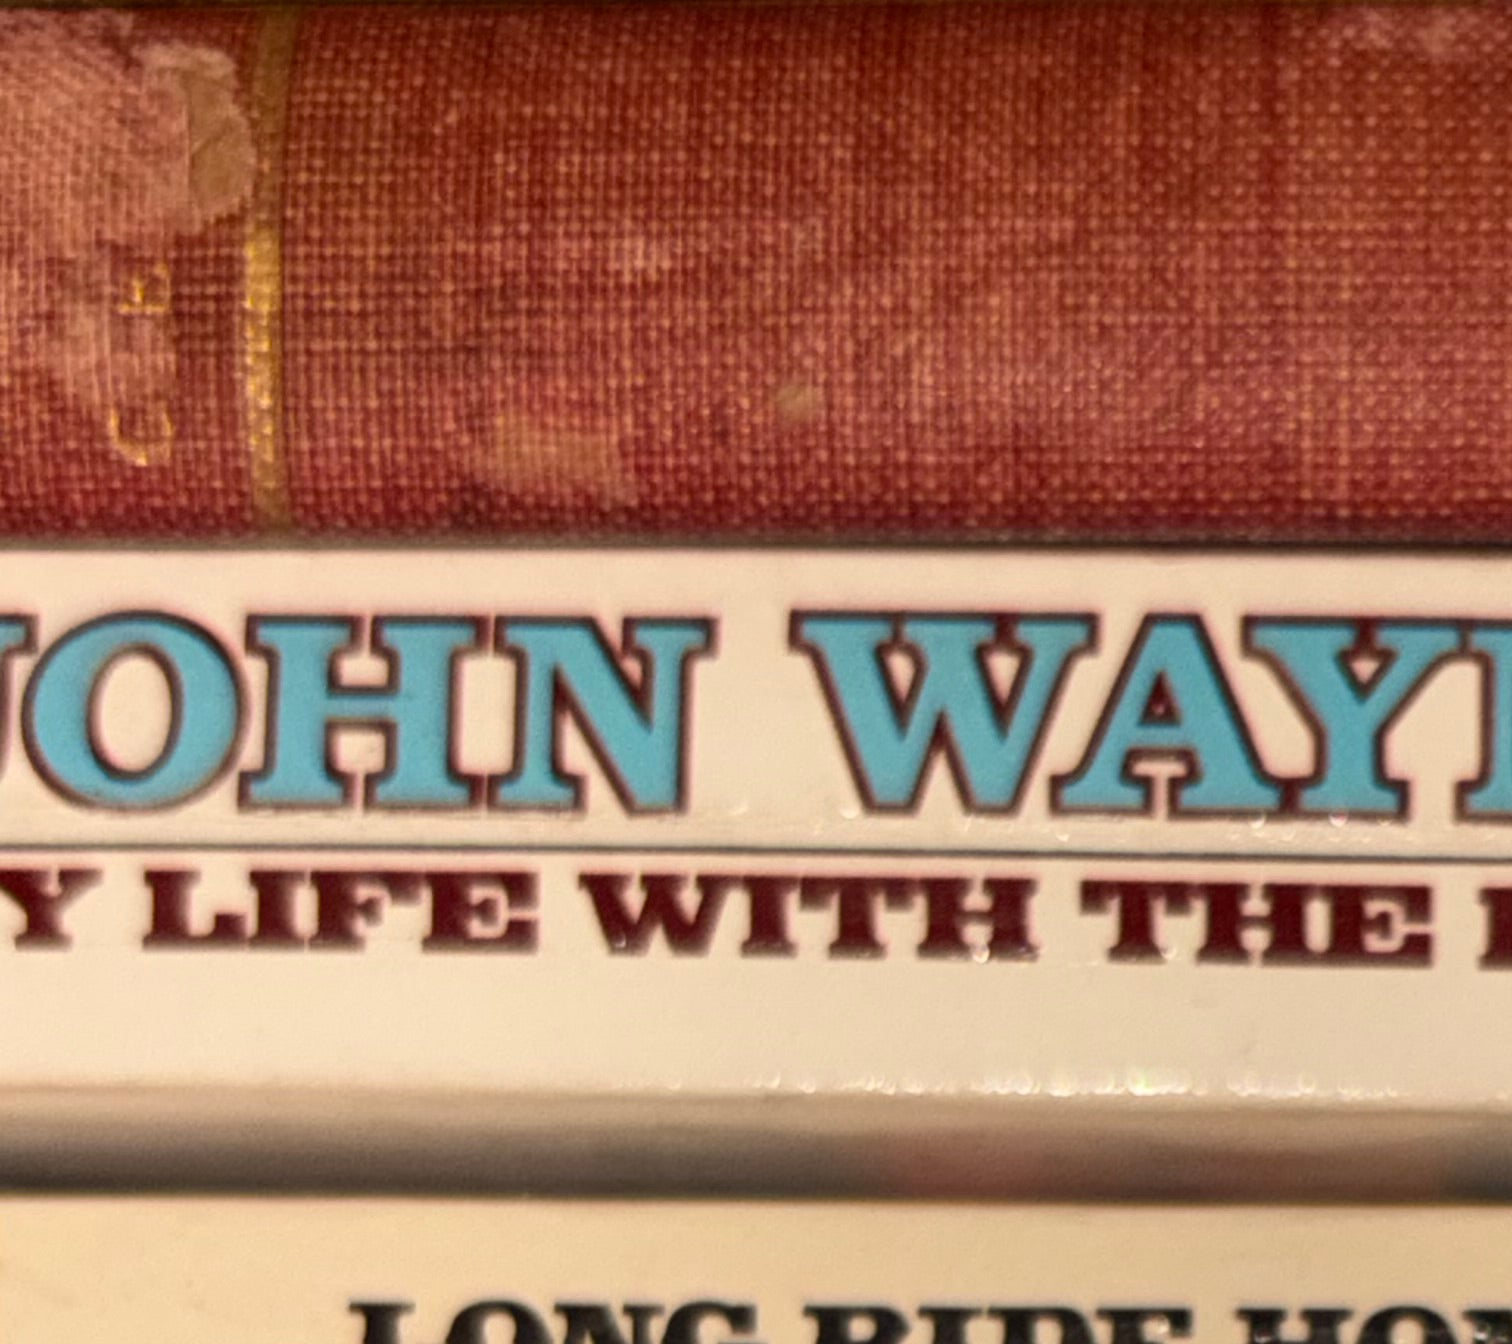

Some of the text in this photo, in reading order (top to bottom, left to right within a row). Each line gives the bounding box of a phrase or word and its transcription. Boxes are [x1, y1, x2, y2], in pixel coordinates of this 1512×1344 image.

[0, 609, 717, 816] OHN
[143, 870, 536, 951] LIFE
[578, 873, 1036, 959] WITH
[1080, 879, 1433, 967] THE
